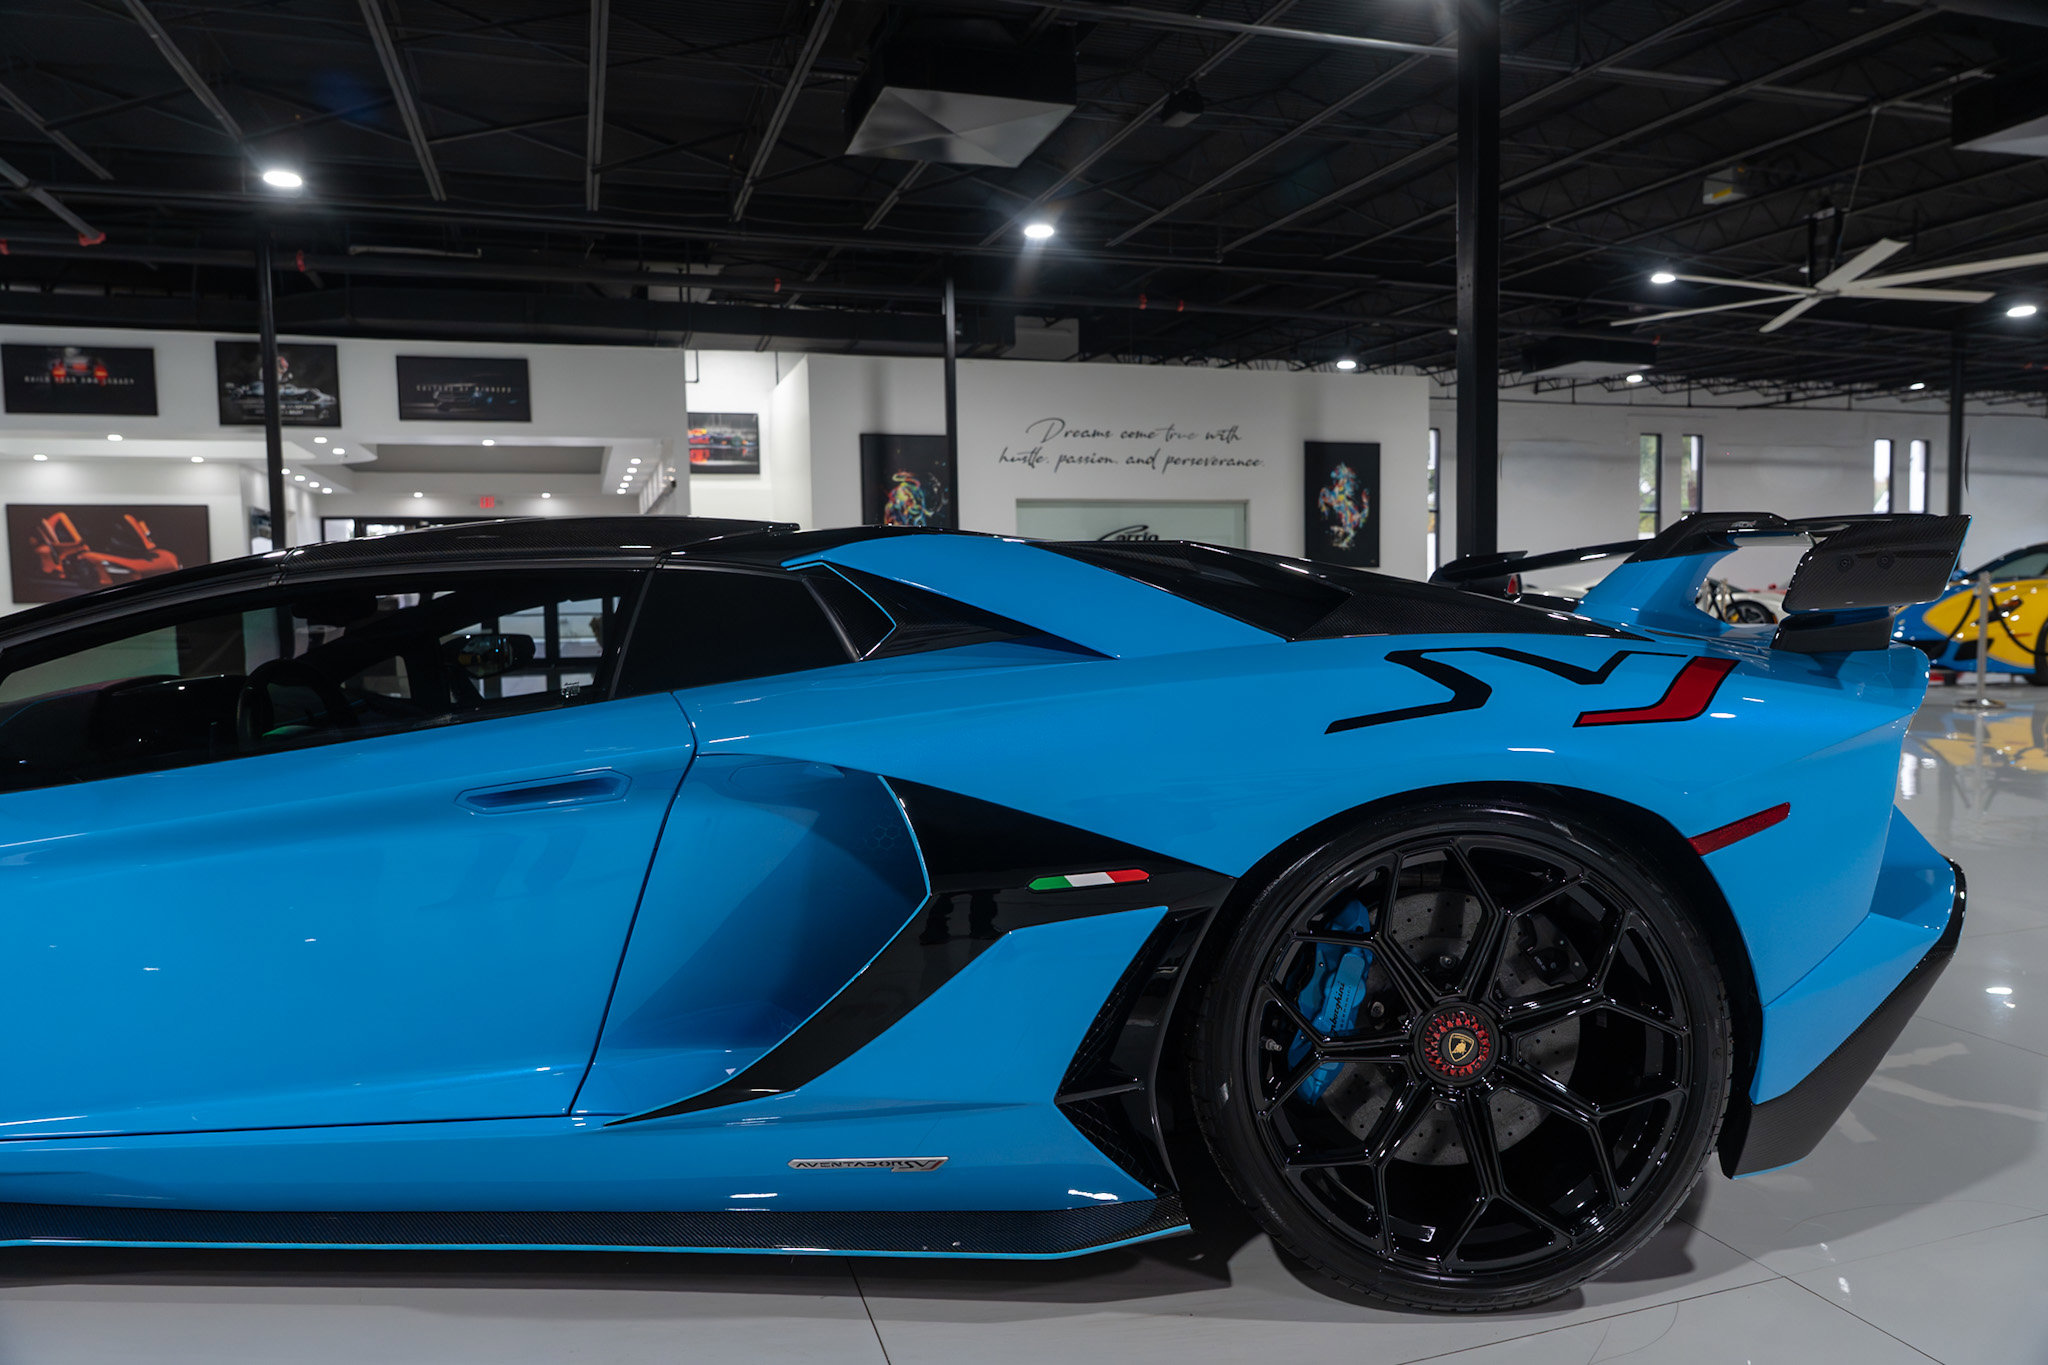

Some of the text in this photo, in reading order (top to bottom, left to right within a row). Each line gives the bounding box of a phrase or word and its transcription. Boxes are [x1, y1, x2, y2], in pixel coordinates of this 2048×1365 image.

[1025, 417, 1242, 444] Dreams come true with
[1125, 447, 1161, 470] and
[796, 1160, 904, 1169] AVENTADOR
